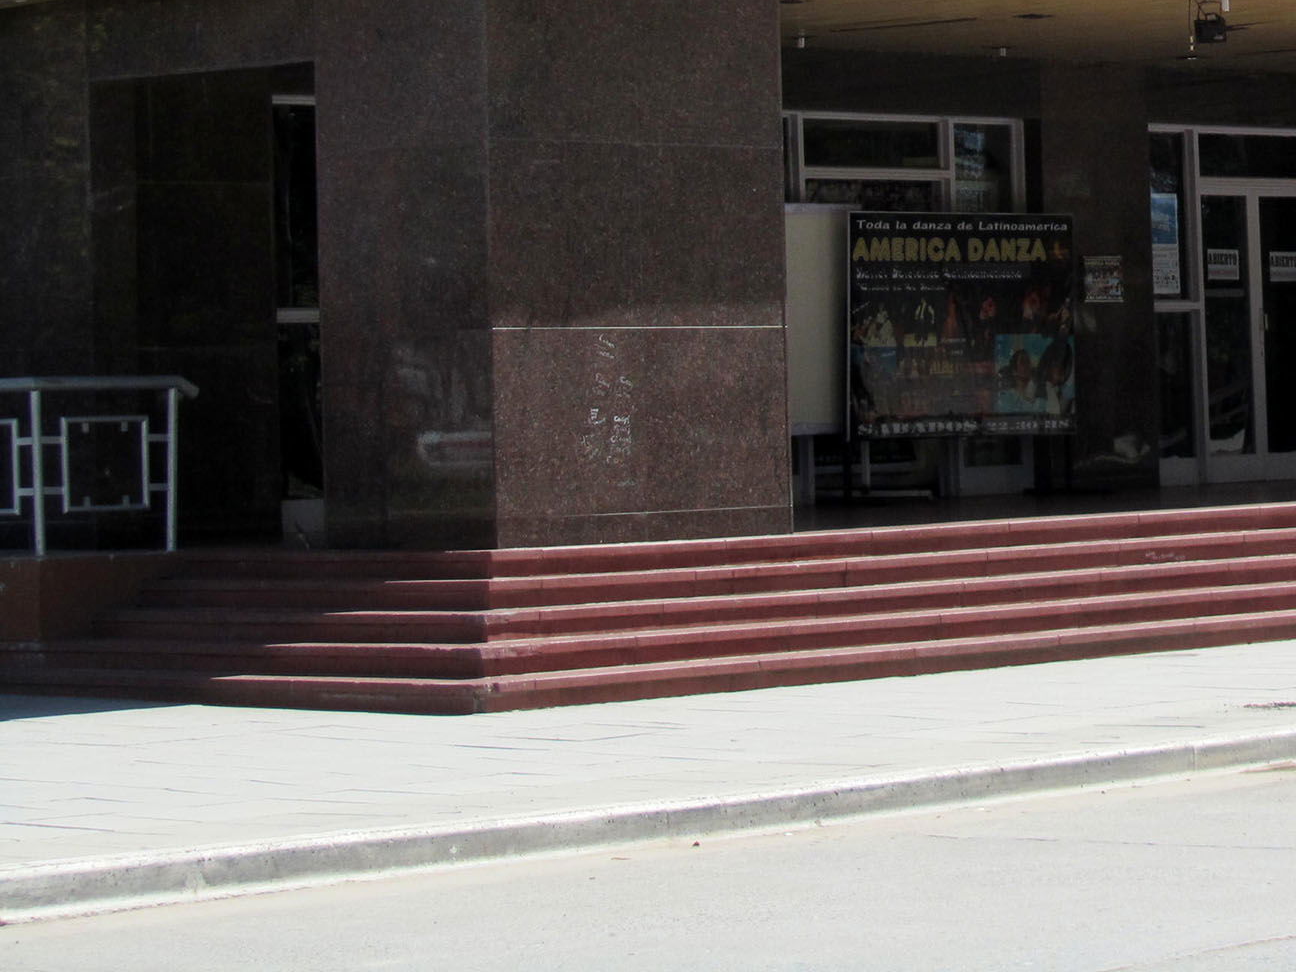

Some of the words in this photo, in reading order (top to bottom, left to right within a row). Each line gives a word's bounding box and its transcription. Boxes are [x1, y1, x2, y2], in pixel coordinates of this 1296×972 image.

[856, 219, 890, 231] Toda
[896, 220, 907, 230] la
[912, 220, 952, 231] danza
[957, 220, 973, 231] de
[978, 220, 1068, 232] Latinoamerica
[852, 236, 962, 262] AMERICA
[967, 237, 1047, 262] DANZA
[1207, 252, 1237, 266] ABIERTO
